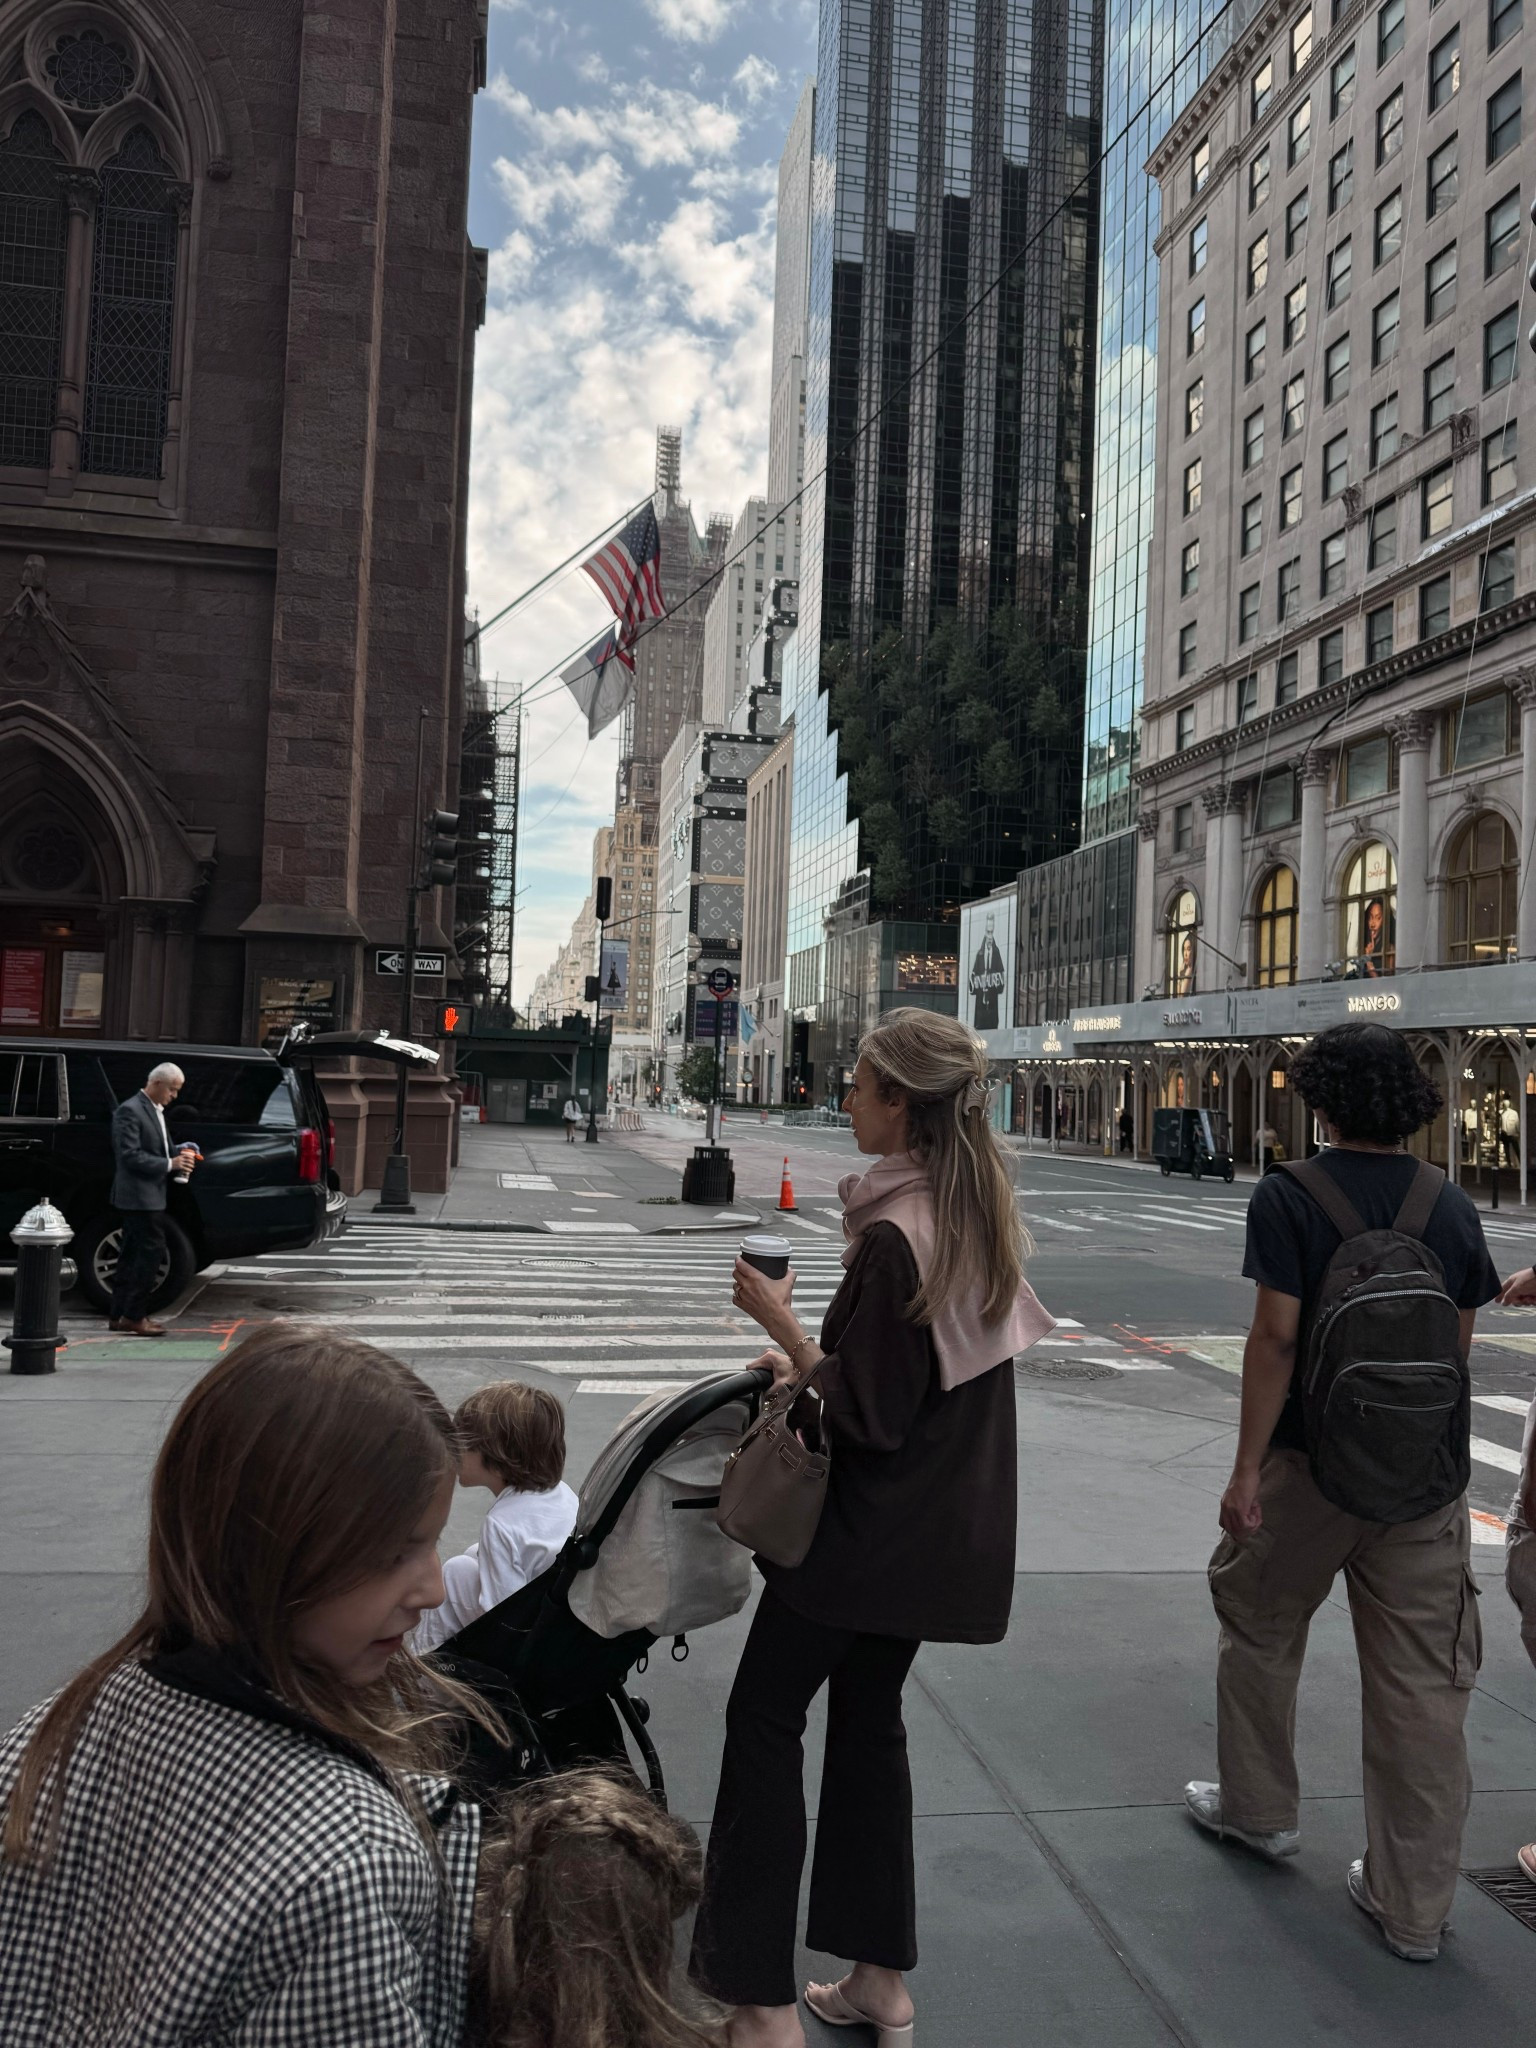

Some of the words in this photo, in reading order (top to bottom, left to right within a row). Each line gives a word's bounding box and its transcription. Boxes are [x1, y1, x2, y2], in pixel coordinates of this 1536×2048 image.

[391, 958, 404, 967] ON
[418, 960, 437, 969] WAY
[1348, 995, 1400, 1012] MANGO
